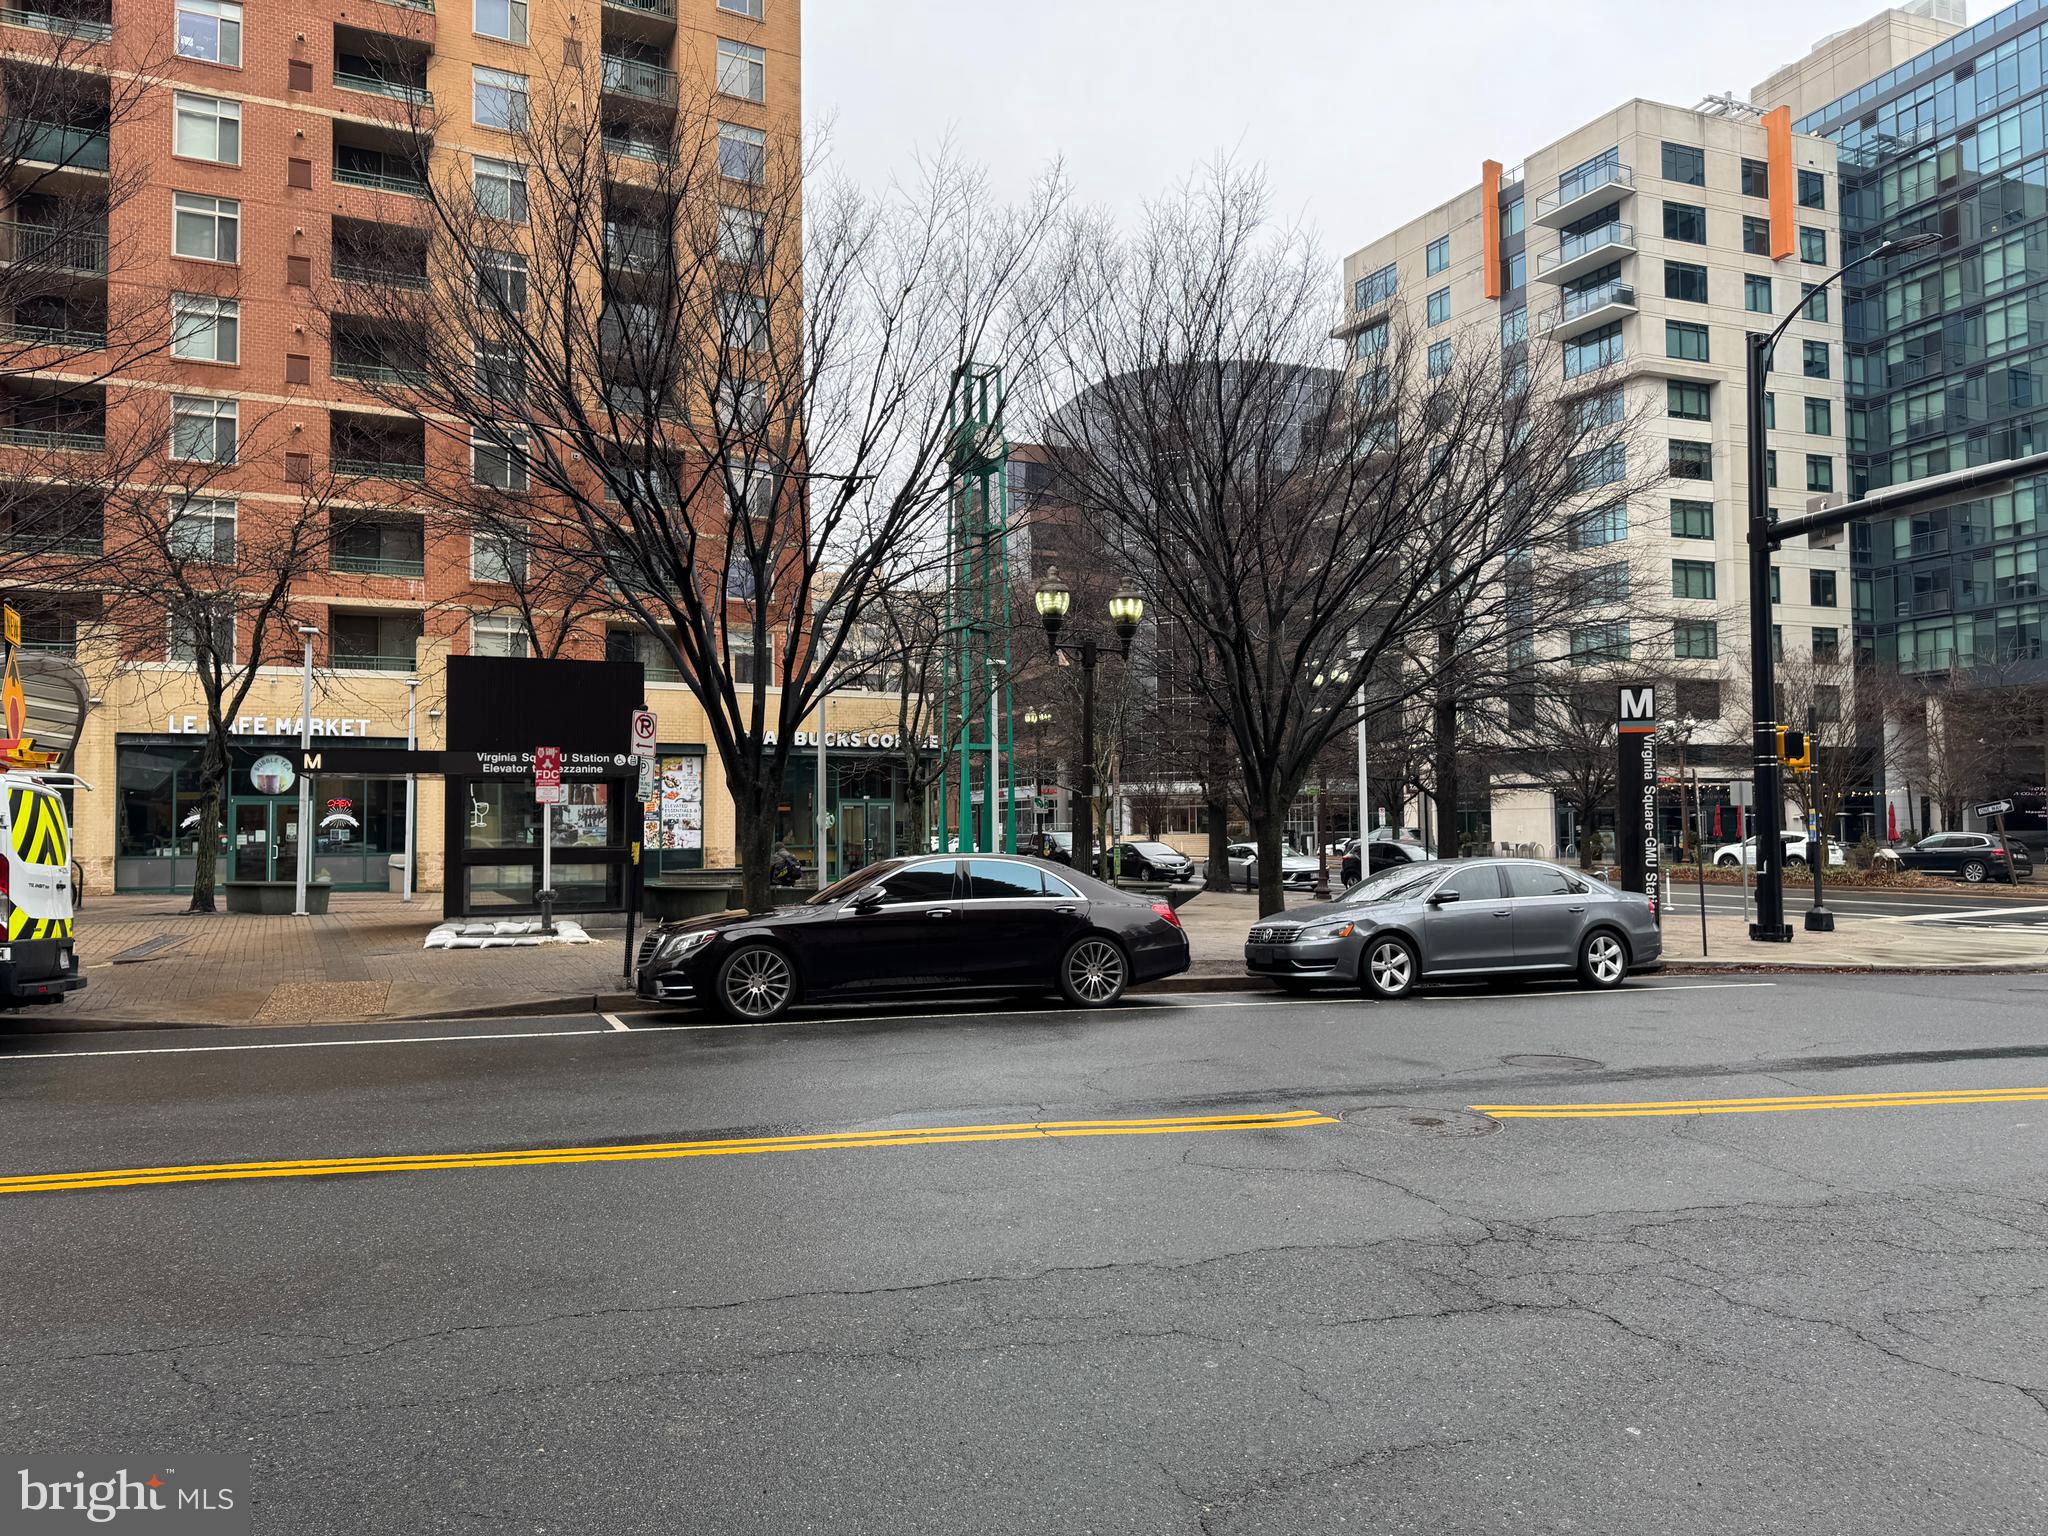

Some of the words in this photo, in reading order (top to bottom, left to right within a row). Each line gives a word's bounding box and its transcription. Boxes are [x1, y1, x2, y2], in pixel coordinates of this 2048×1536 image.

[1620, 688, 1654, 719] M
[168, 715, 198, 734] LE
[206, 712, 268, 736] AFÉ
[275, 717, 371, 737] MARKET
[743, 730, 861, 748] ABUCKS
[303, 753, 322, 769] M
[477, 752, 517, 763] Virginia
[571, 753, 610, 763] Station
[1641, 733, 1655, 780] Virginia
[482, 764, 527, 773] Elevator
[558, 764, 604, 773] ezzanine
[536, 769, 560, 779] FDC
[326, 799, 352, 808] OPEN
[1642, 785, 1657, 867] Square-GMU
[1645, 872, 1658, 903] Stat
